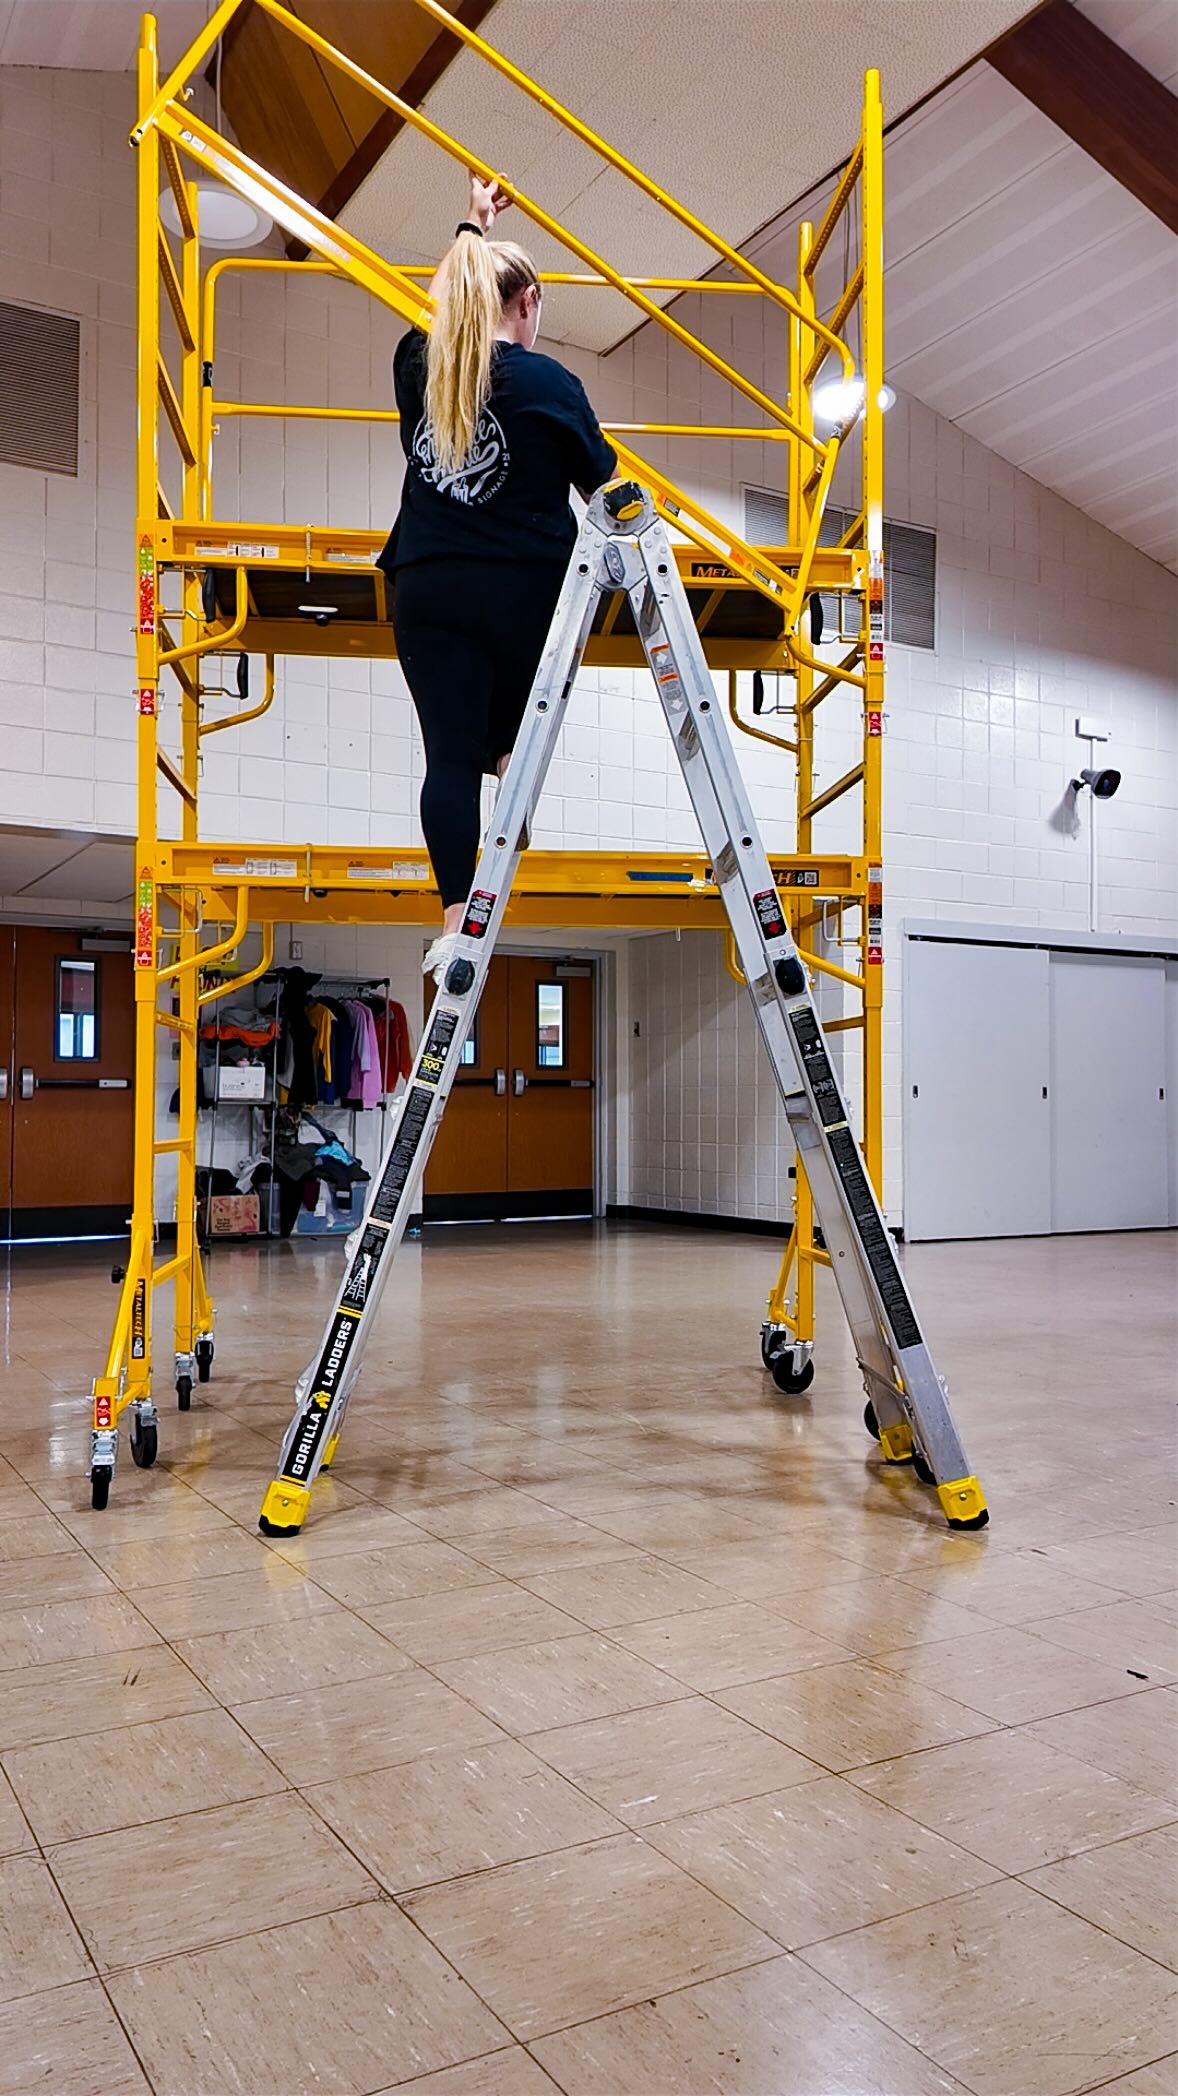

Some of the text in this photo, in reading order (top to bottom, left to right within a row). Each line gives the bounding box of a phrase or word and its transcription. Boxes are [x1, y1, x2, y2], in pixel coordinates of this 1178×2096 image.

[477, 471, 508, 504] SIGNAGE
[421, 1058, 440, 1071] 300
[291, 1319, 353, 1475] GORILLA LADDERS
